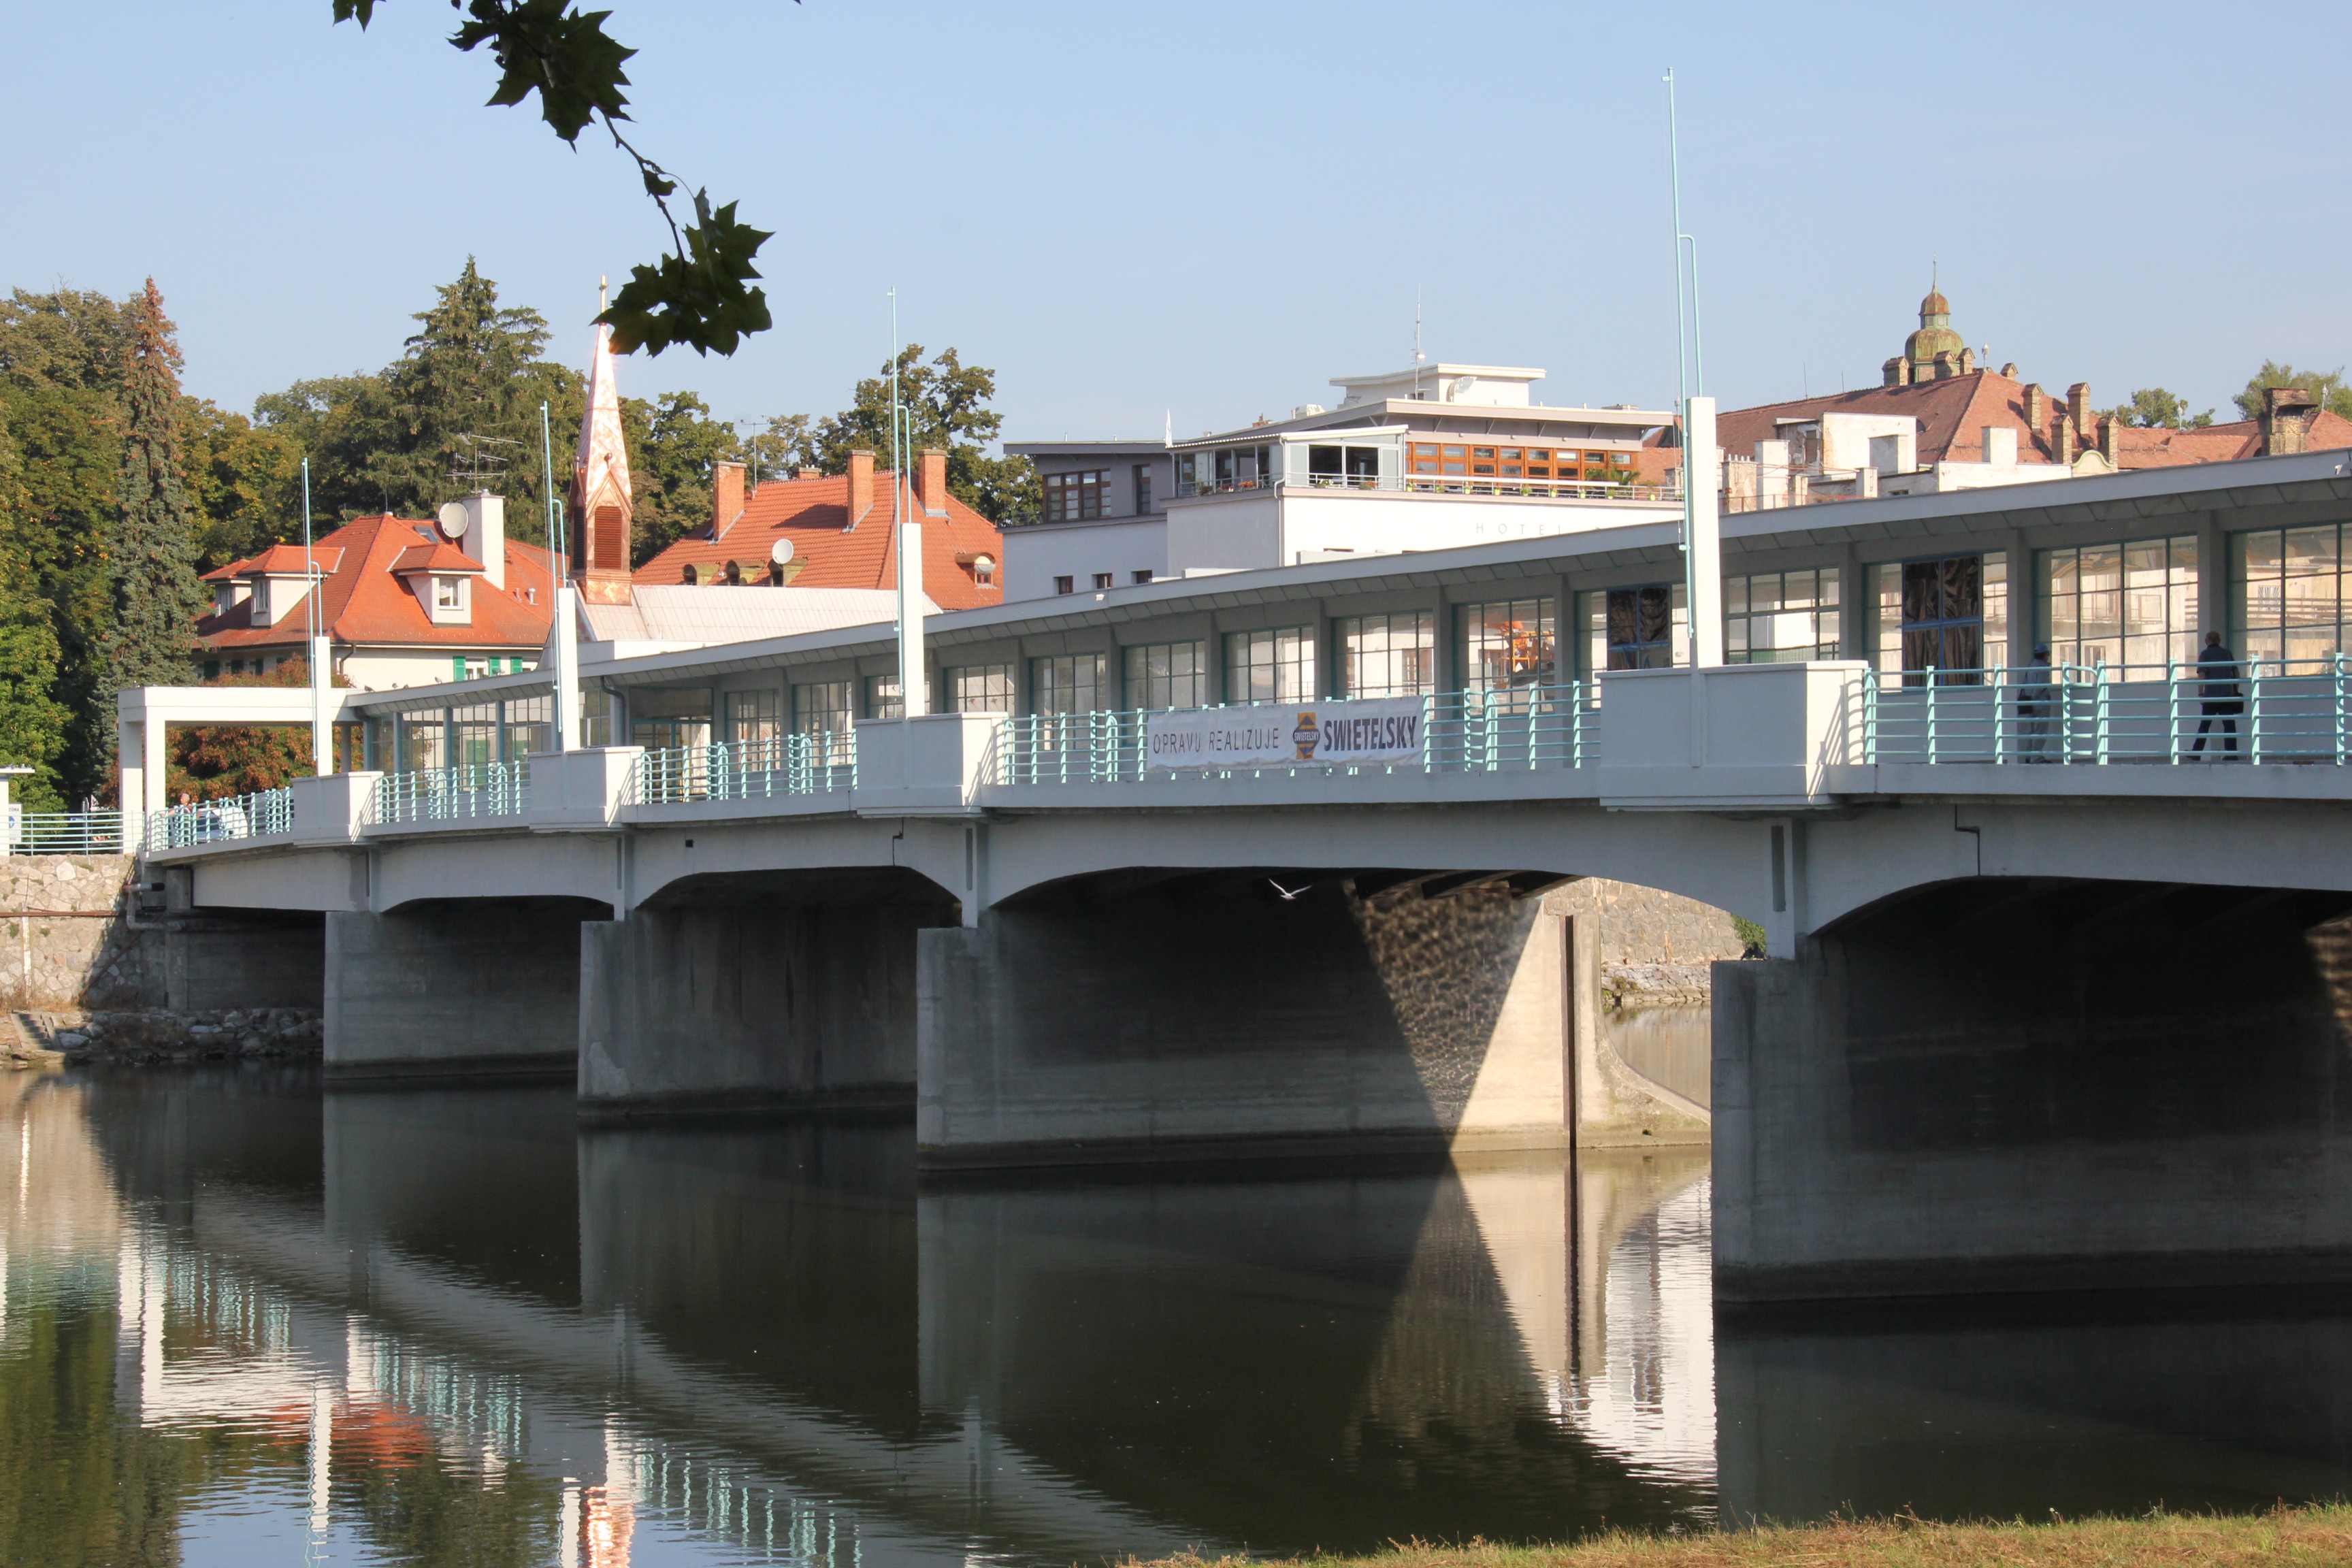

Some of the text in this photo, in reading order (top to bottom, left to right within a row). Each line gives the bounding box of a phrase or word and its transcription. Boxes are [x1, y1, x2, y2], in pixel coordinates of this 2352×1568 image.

[1153, 728, 1279, 753] OPRAVU REALIZUJE
[1294, 731, 1320, 742] SWIETELSKY
[1324, 715, 1417, 752] SWIETELSKY
